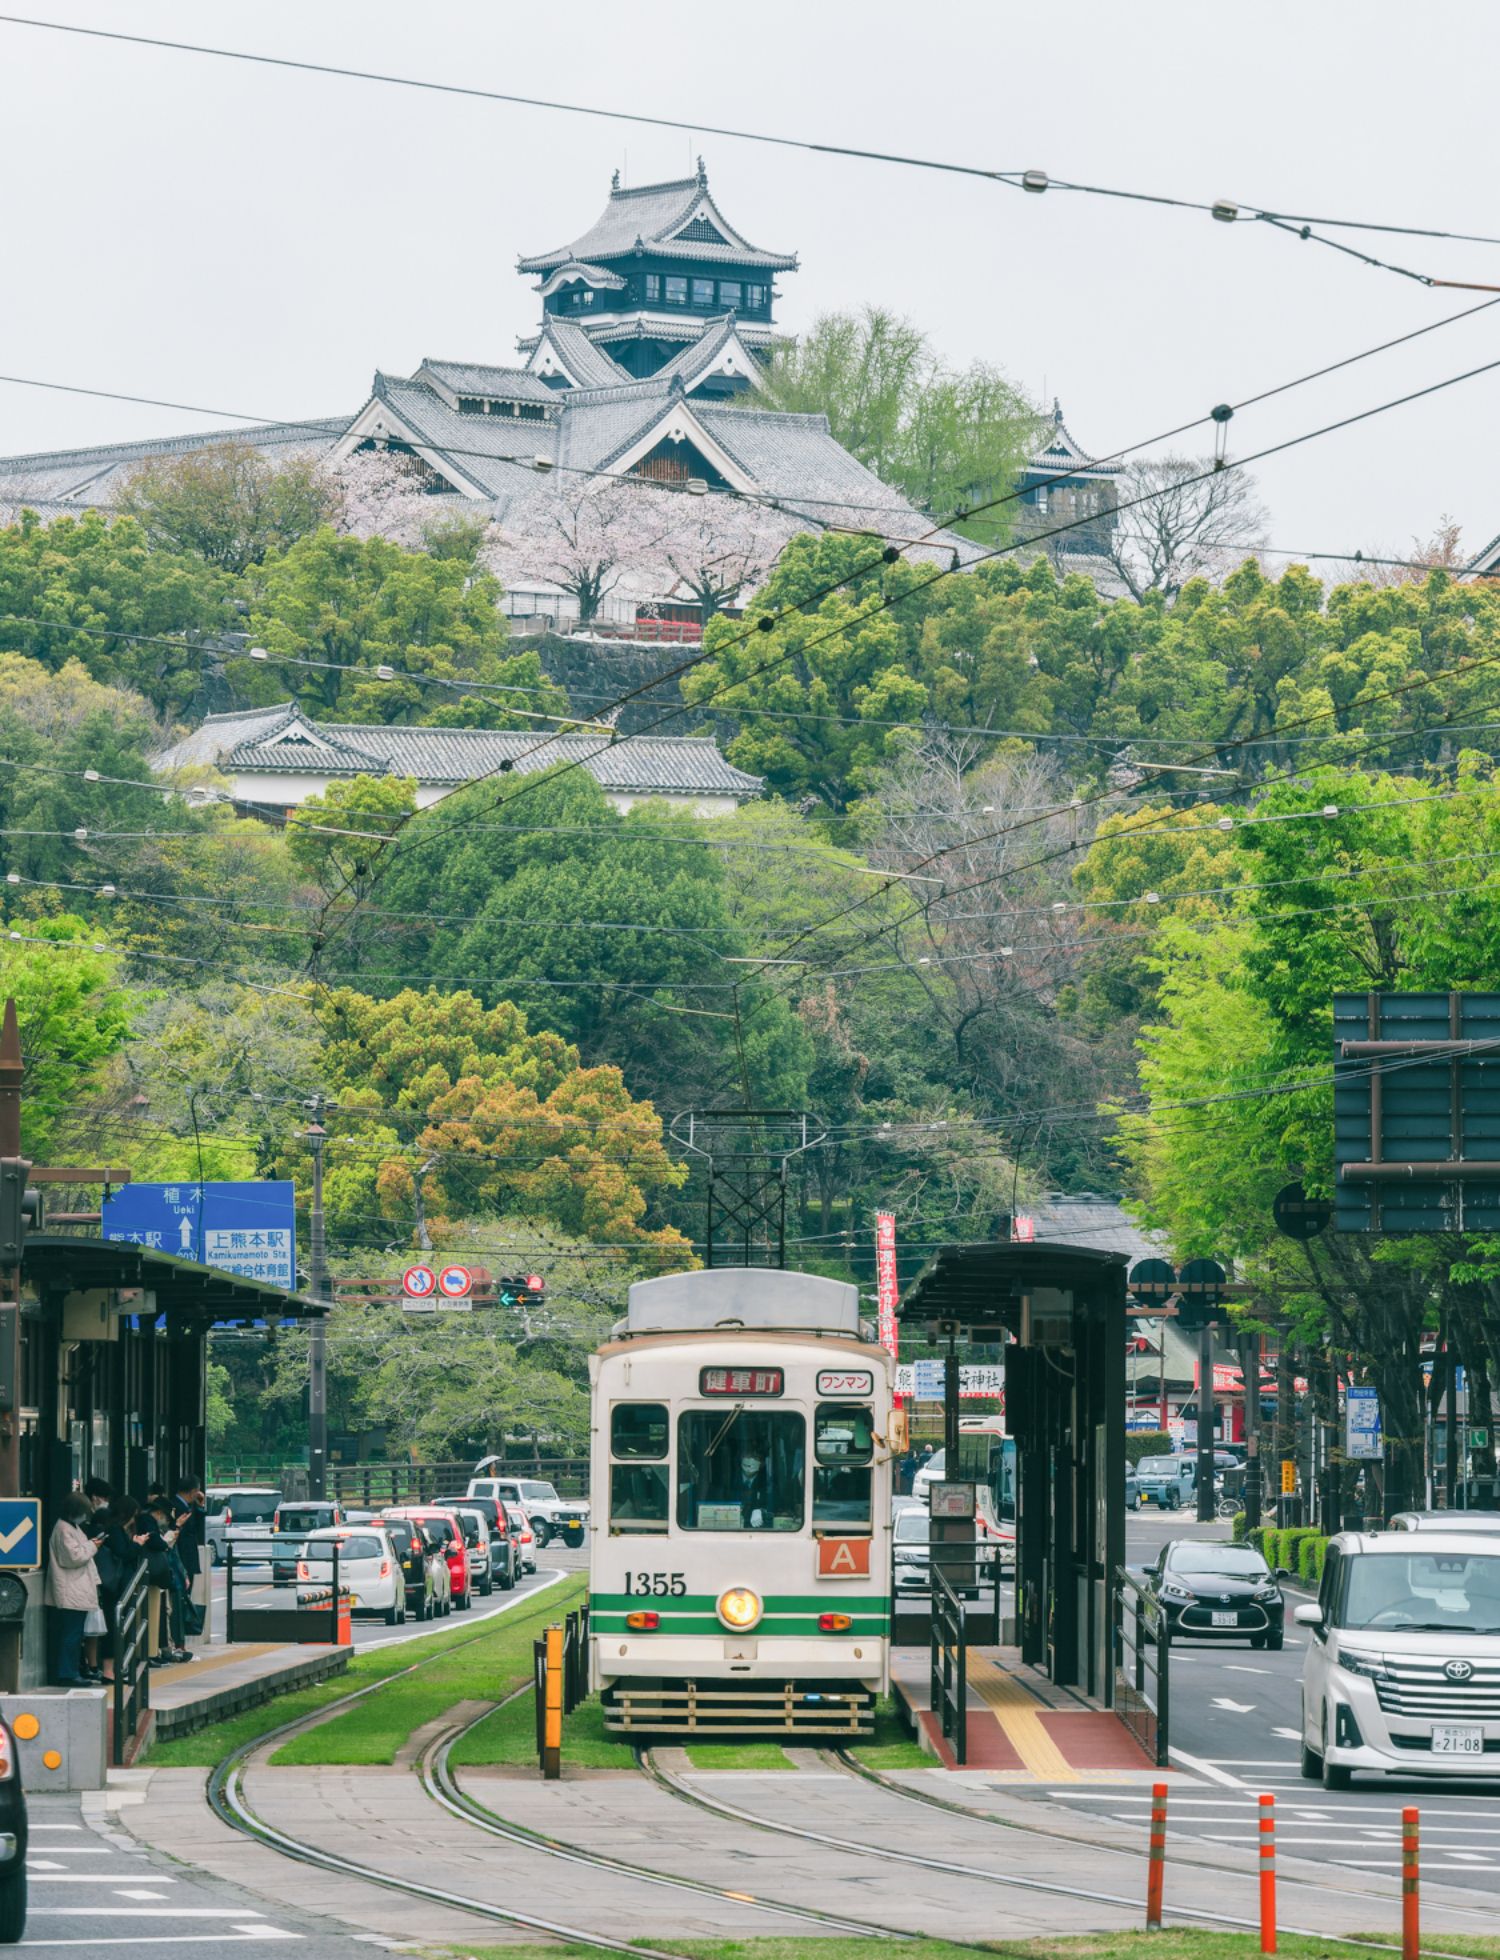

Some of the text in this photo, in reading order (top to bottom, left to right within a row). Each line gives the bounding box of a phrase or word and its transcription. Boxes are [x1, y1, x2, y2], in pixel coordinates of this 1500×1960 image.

[164, 1187, 206, 1204] 植木
[173, 1205, 195, 1214] Ueki
[213, 1232, 285, 1249] 上熊本駅
[207, 1250, 268, 1259] Kamikumamoto
[706, 1370, 777, 1393] 健軍町
[821, 1376, 868, 1389] ワンマン
[830, 1543, 857, 1571] A
[624, 1571, 687, 1597] 1355
[1443, 1737, 1480, 1752] 21-08
